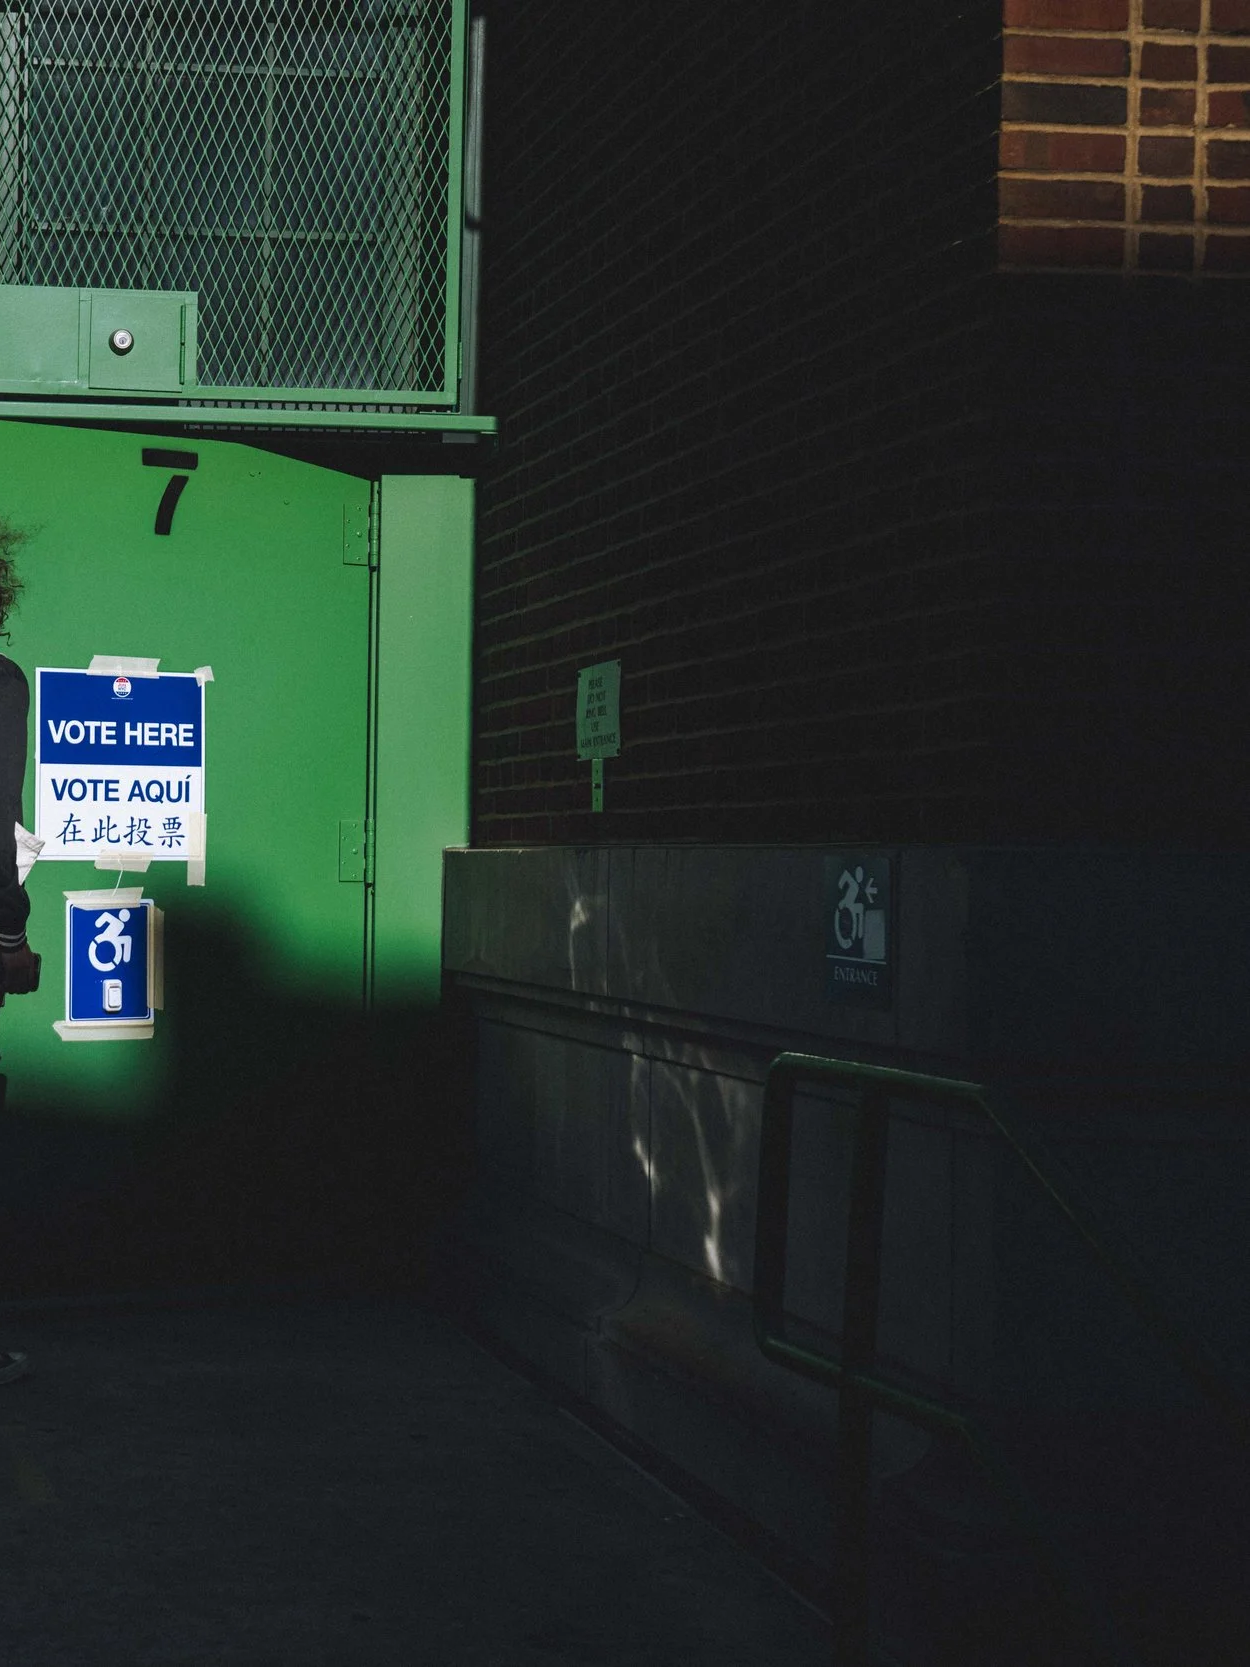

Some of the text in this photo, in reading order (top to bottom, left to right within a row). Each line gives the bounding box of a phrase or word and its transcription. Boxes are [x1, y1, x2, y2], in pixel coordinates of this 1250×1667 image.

[142, 447, 198, 535] 7
[48, 719, 194, 746] VOTE HERE
[51, 775, 192, 804] VOTE AQUÍ
[56, 812, 186, 848] 在此投票
[834, 966, 878, 986] ENTRANCE
